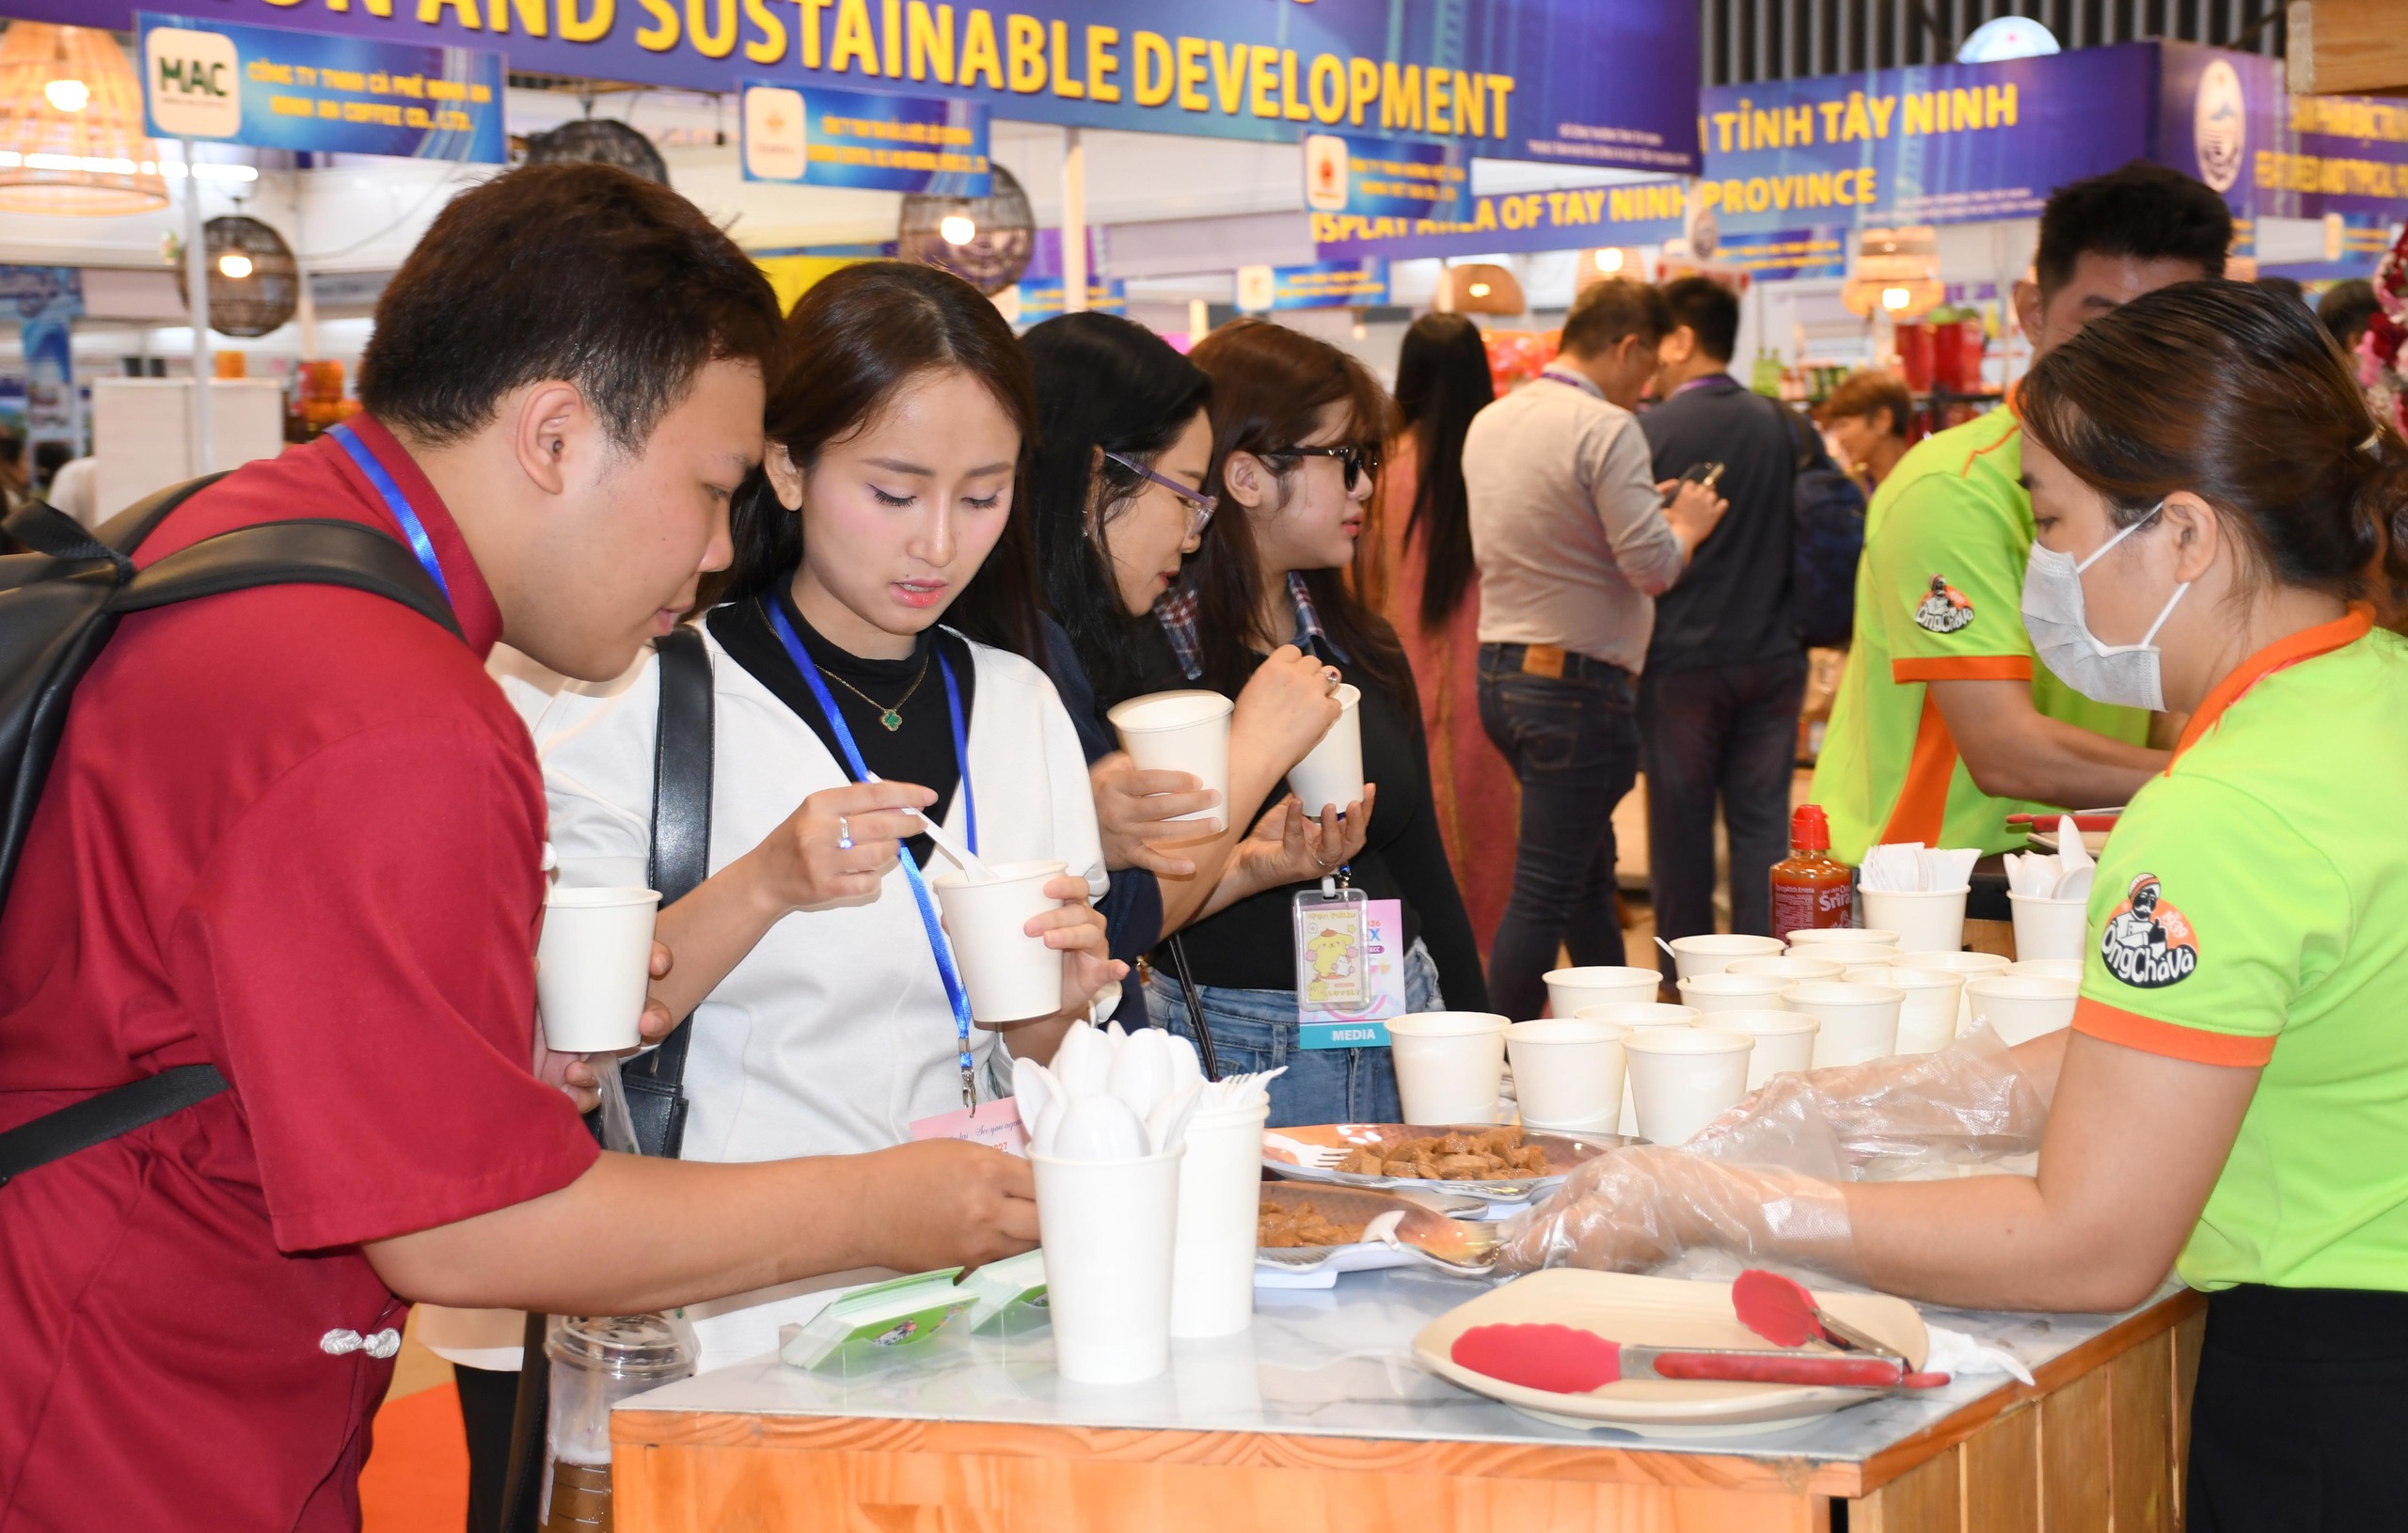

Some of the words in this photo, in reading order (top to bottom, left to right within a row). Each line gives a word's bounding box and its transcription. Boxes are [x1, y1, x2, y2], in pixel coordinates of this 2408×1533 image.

[158, 55, 229, 98] MAC
[635, 0, 1122, 103] SUSTAINABLE
[1133, 30, 1515, 140] DEVELOPMENT
[1817, 90, 1897, 144] TÂY
[1903, 82, 2019, 135] NINH
[1500, 194, 1543, 230] OF
[1547, 190, 1606, 227] TAY
[1702, 166, 1878, 215] PROVINCE
[1331, 1029, 1376, 1042] MEDIA
